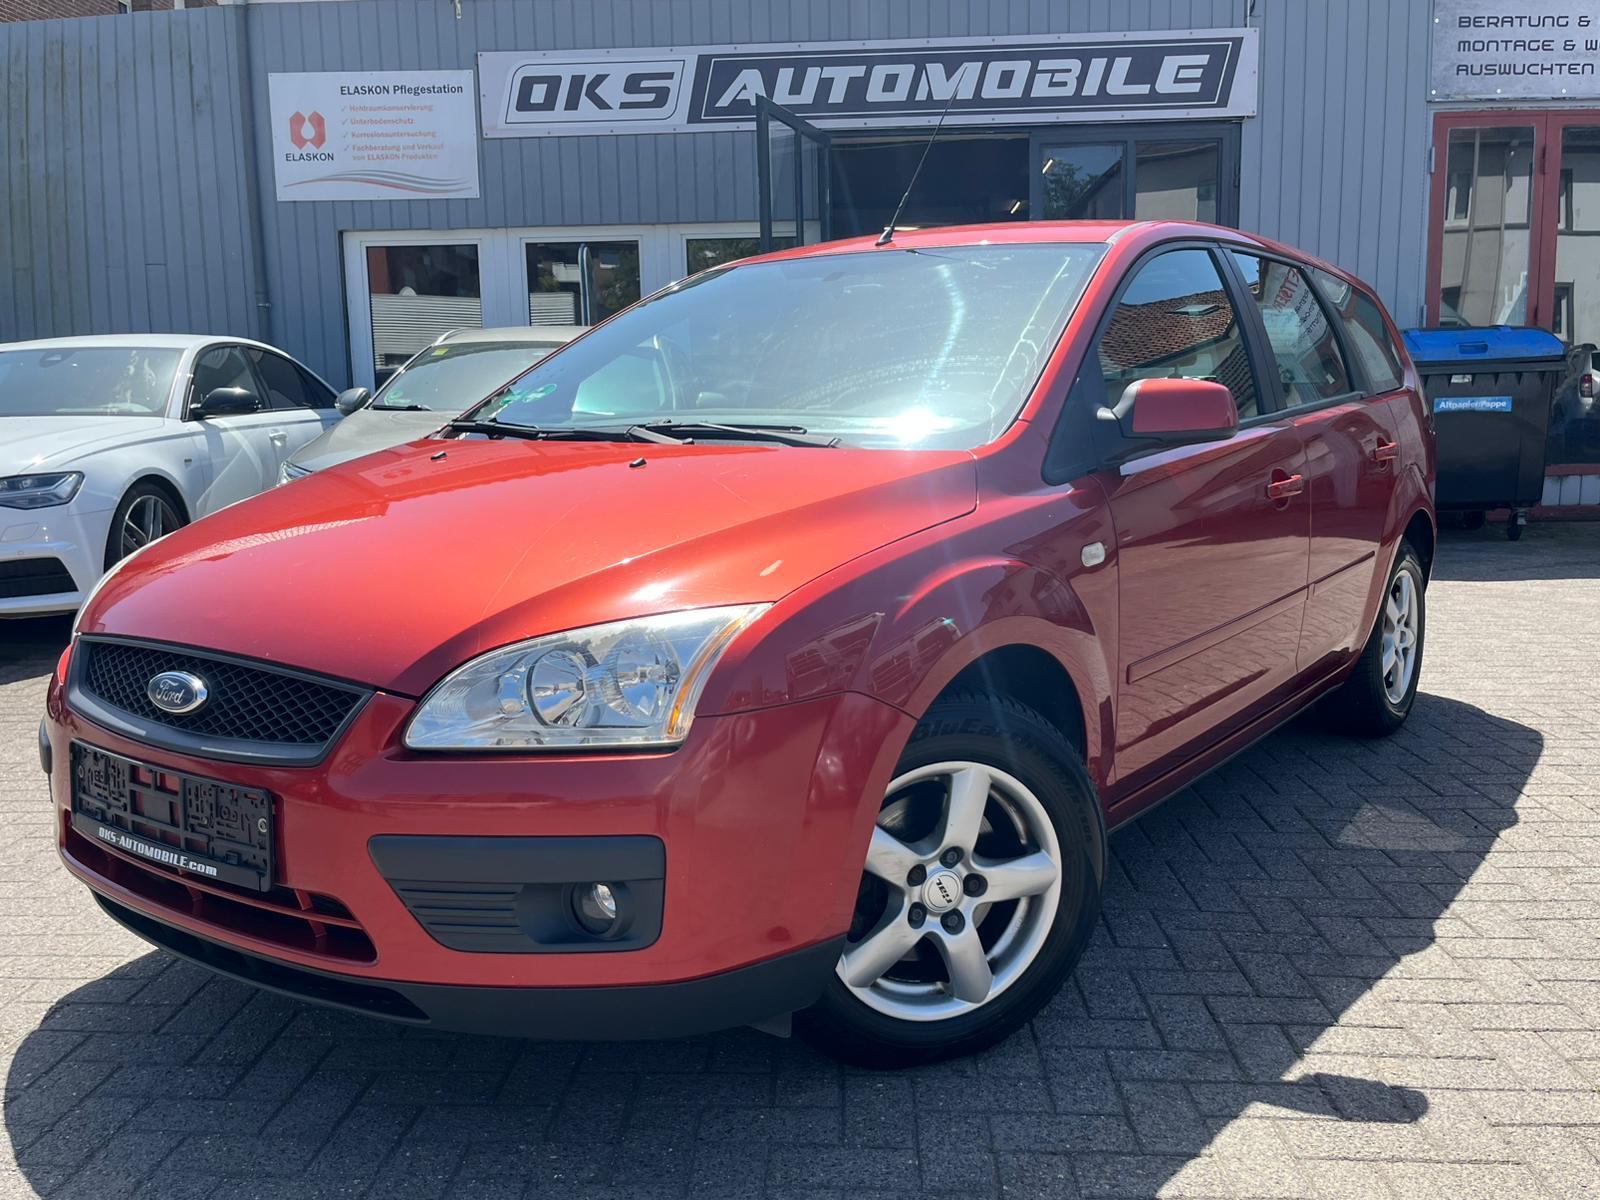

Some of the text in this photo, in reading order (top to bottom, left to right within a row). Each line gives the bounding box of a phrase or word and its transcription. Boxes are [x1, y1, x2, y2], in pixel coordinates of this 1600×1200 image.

[1458, 15, 1591, 28] BERATUNG &
[1457, 39, 1555, 52] MONTAGE
[1563, 39, 1576, 51] &
[1456, 63, 1594, 76] AUSWUCHTEN
[514, 54, 1211, 112] OKS AUTOMOBILE
[340, 84, 463, 97] ELASKON Pflegestation
[285, 152, 334, 162] ELASKON
[156, 679, 186, 704] Ford
[98, 826, 218, 877] OKS-AUTOMOBILE.com
